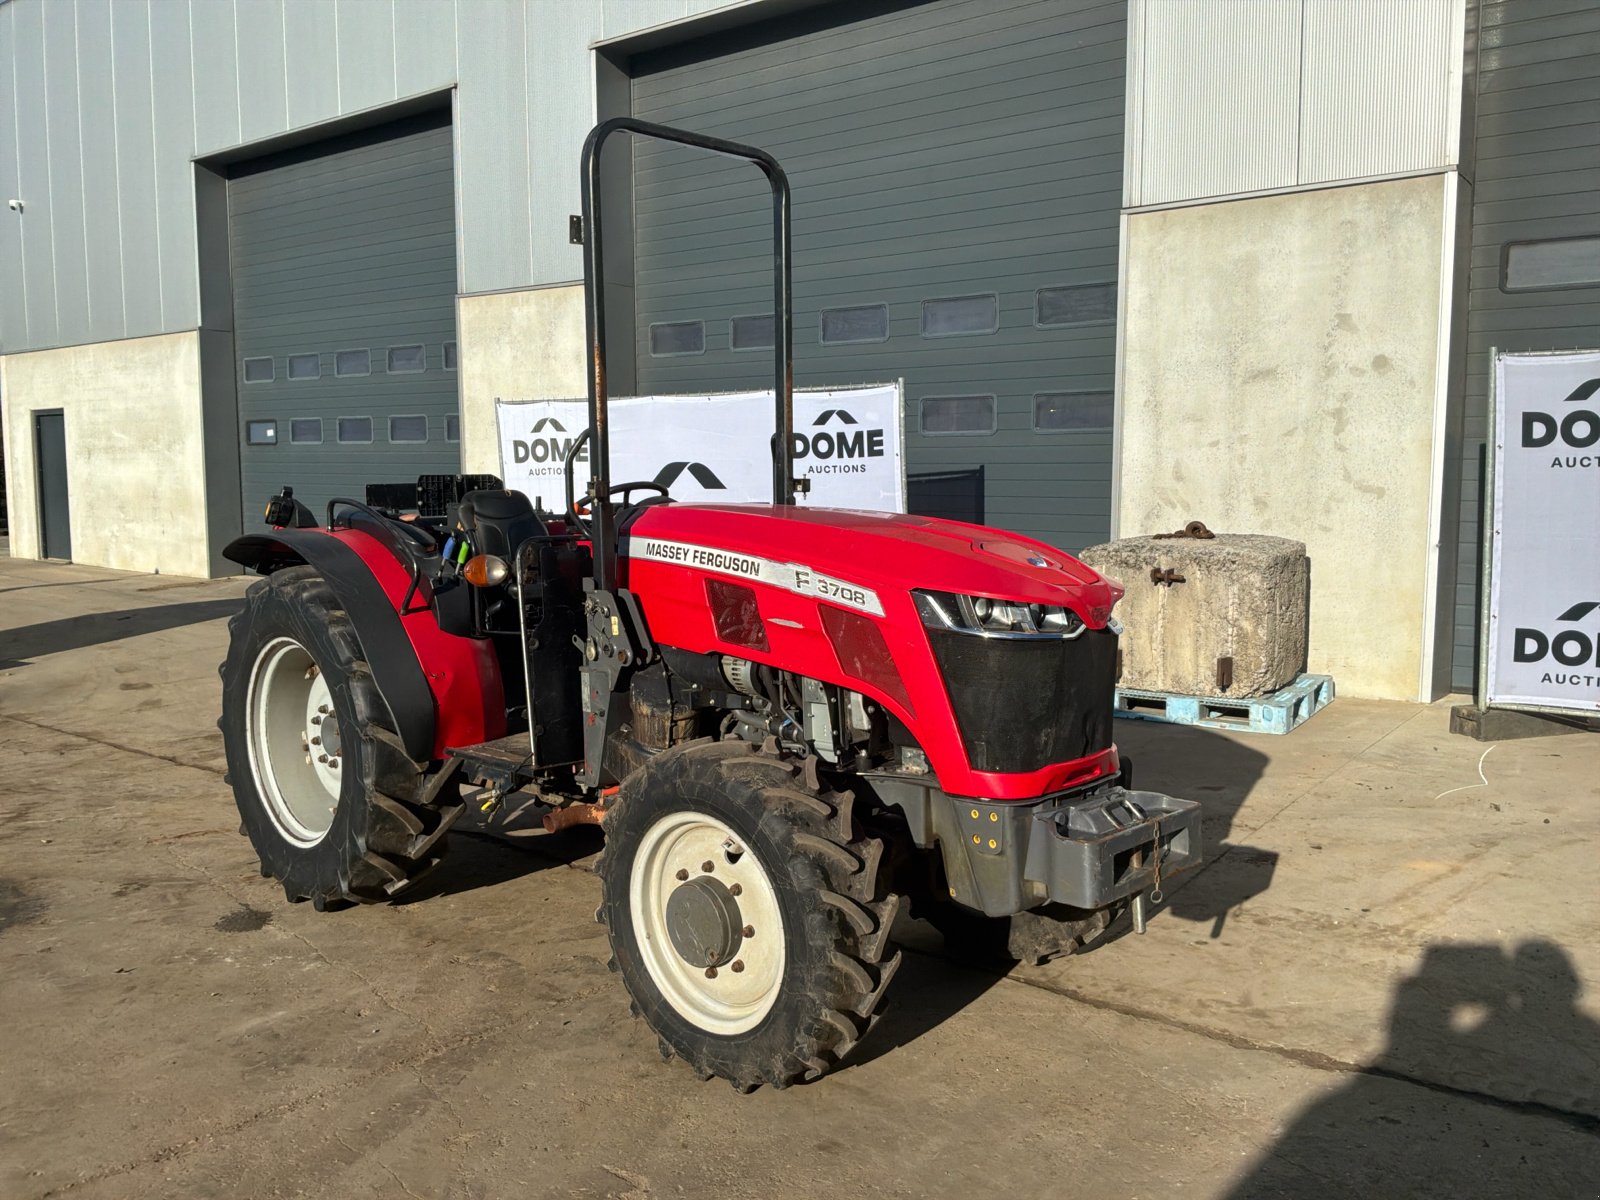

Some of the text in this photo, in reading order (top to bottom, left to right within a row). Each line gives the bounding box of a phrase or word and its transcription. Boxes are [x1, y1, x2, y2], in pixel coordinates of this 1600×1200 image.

[513, 437, 589, 464] DOME
[791, 429, 884, 460] DOME
[528, 467, 575, 477] AUCTIO
[807, 464, 866, 474] AUCTIONS
[646, 542, 866, 606] MASSEY FERGUSON F 3708
[1513, 627, 1600, 668] DO
